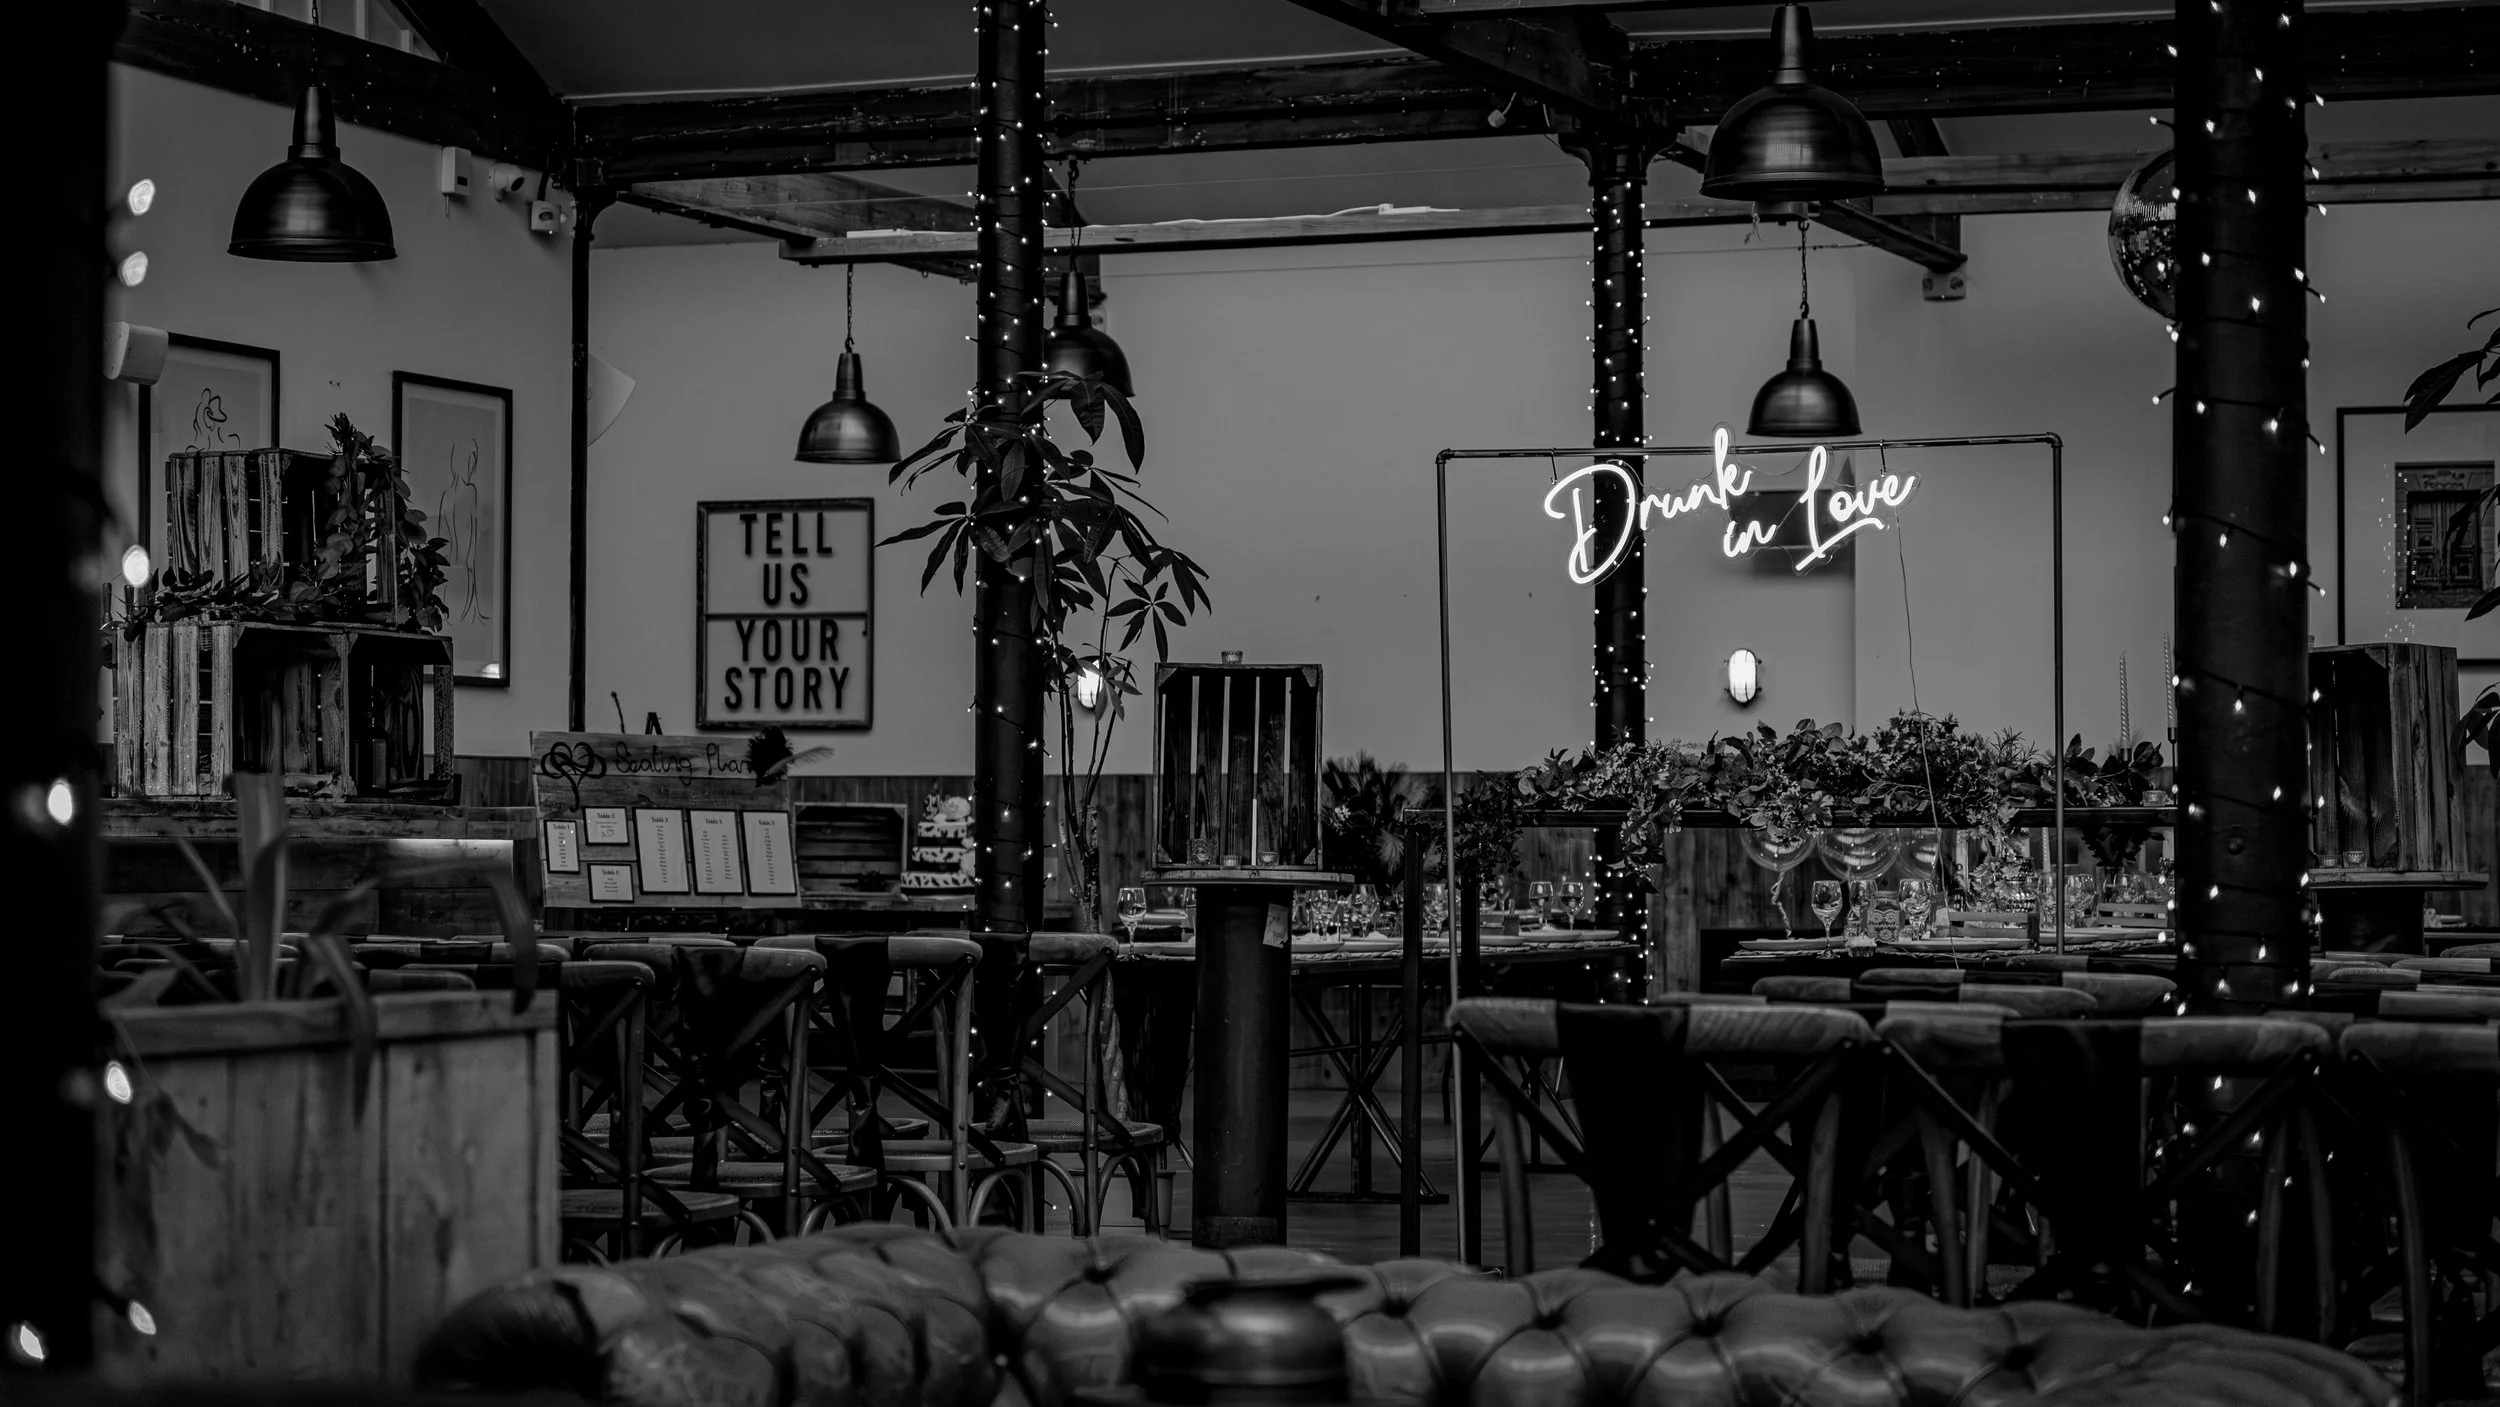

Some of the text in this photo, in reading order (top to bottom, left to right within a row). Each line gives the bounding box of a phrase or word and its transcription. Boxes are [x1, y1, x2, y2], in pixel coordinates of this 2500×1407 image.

[1544, 427, 1754, 584] Drunk
[1723, 445, 1916, 571] in Love
[740, 512, 832, 555] TELL
[763, 563, 808, 606] US
[735, 619, 839, 662] YOUR
[724, 667, 849, 709] STORY
[615, 742, 752, 786] Seating Plan
